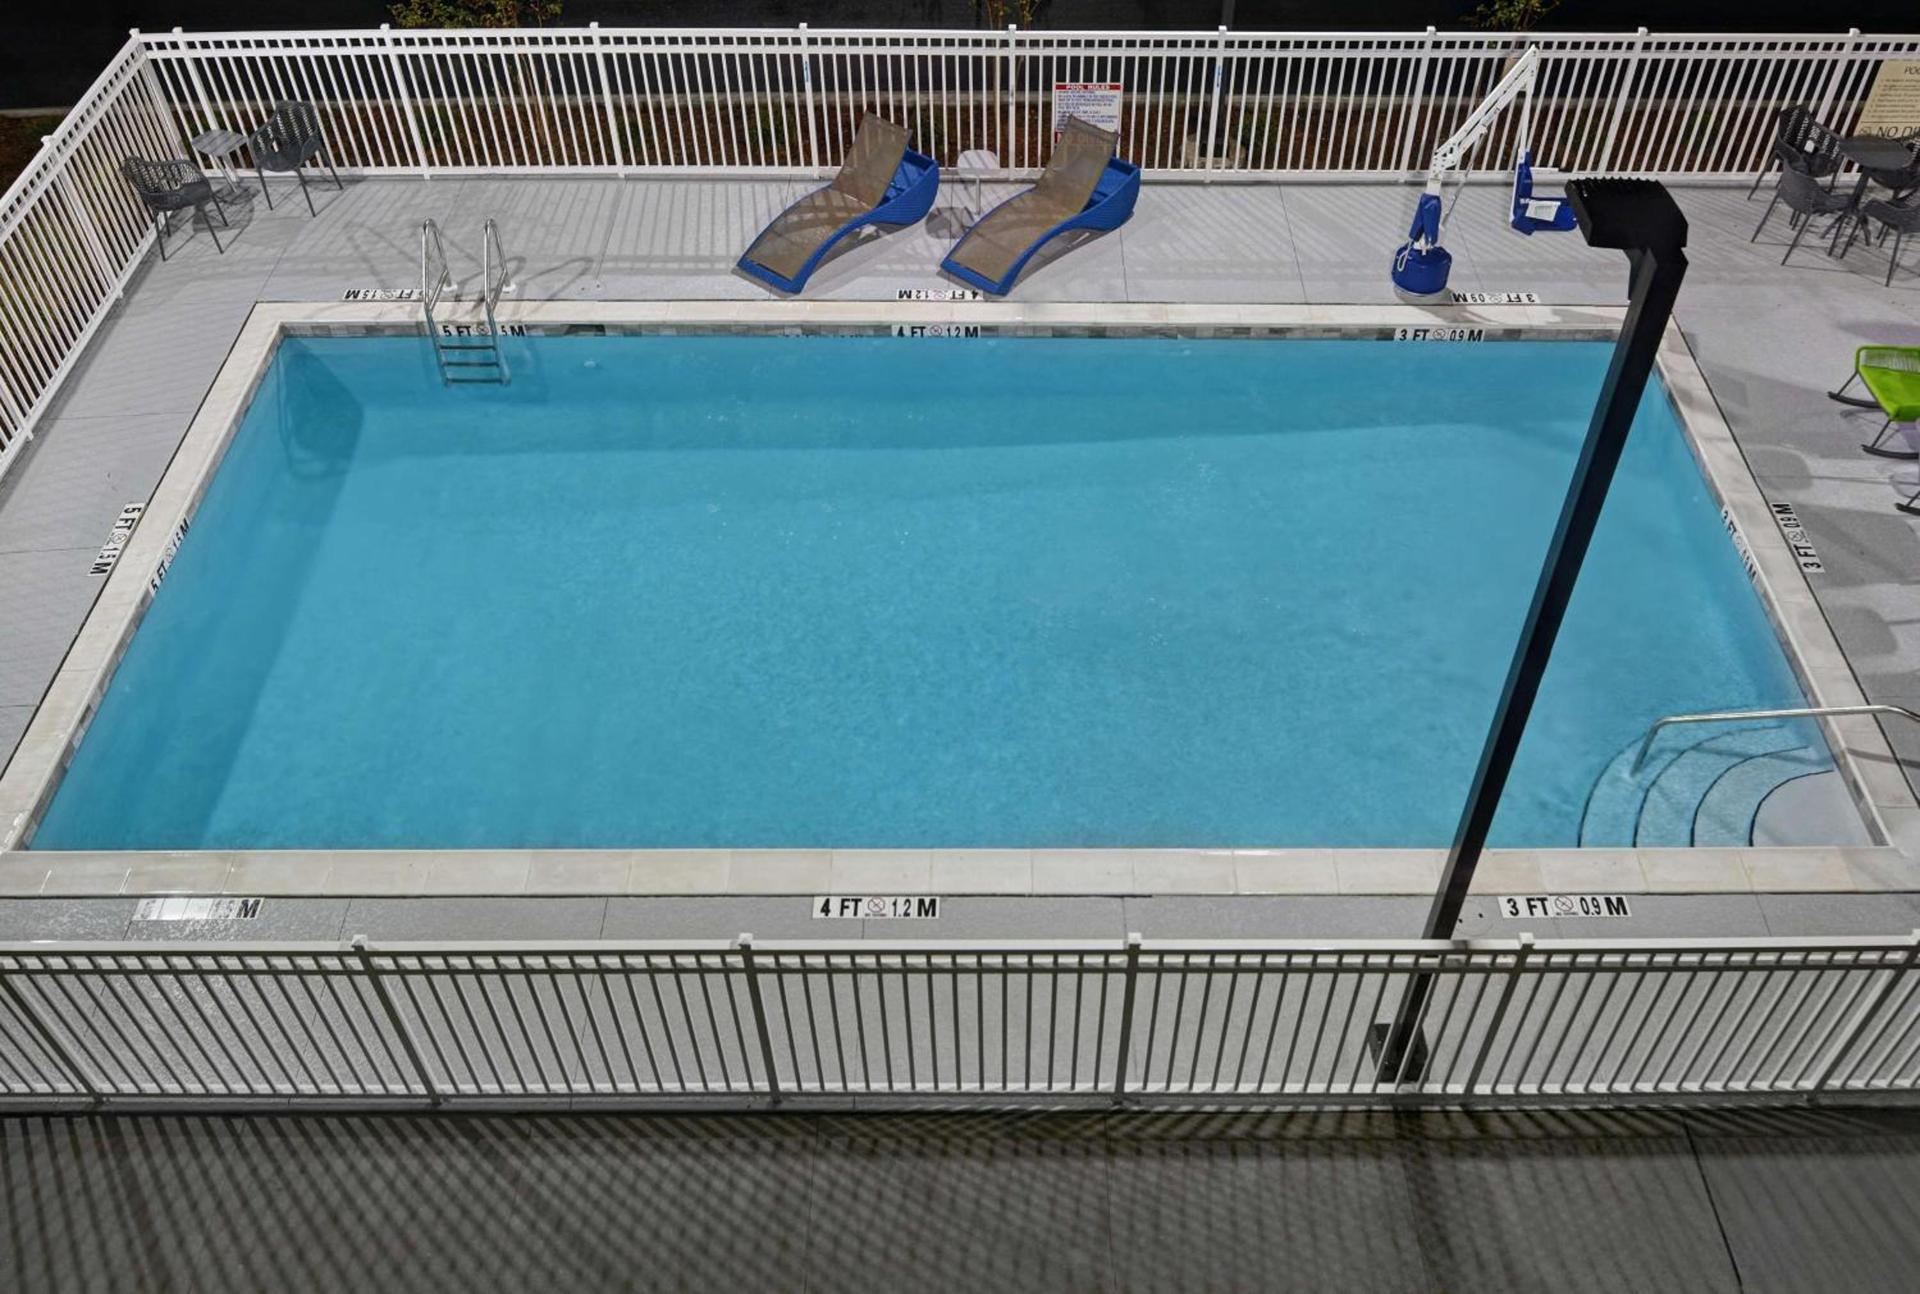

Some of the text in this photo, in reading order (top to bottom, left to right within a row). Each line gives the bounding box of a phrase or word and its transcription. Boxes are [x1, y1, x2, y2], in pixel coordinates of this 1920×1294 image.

[1876, 126, 1899, 138] NO
[345, 289, 360, 299] M
[898, 289, 912, 299] M
[951, 290, 965, 300] FT
[1453, 293, 1468, 303] M
[1506, 294, 1521, 303] FT
[1526, 294, 1535, 303] 3
[442, 324, 451, 337] 5
[456, 325, 472, 337] FT
[511, 325, 525, 337] M
[897, 325, 905, 337] 4
[911, 326, 926, 338] FT
[965, 326, 979, 338] M
[1400, 329, 1408, 341] 3
[1412, 329, 1430, 342] FT
[1468, 329, 1483, 342] M
[1772, 504, 1794, 515] M
[115, 518, 136, 530] FT
[1793, 544, 1817, 558] FT
[90, 562, 112, 575] M
[236, 899, 260, 918] M
[820, 897, 937, 917] 4 FT 1.2 M
[1507, 896, 1628, 916] 3 FT 0.9 M
